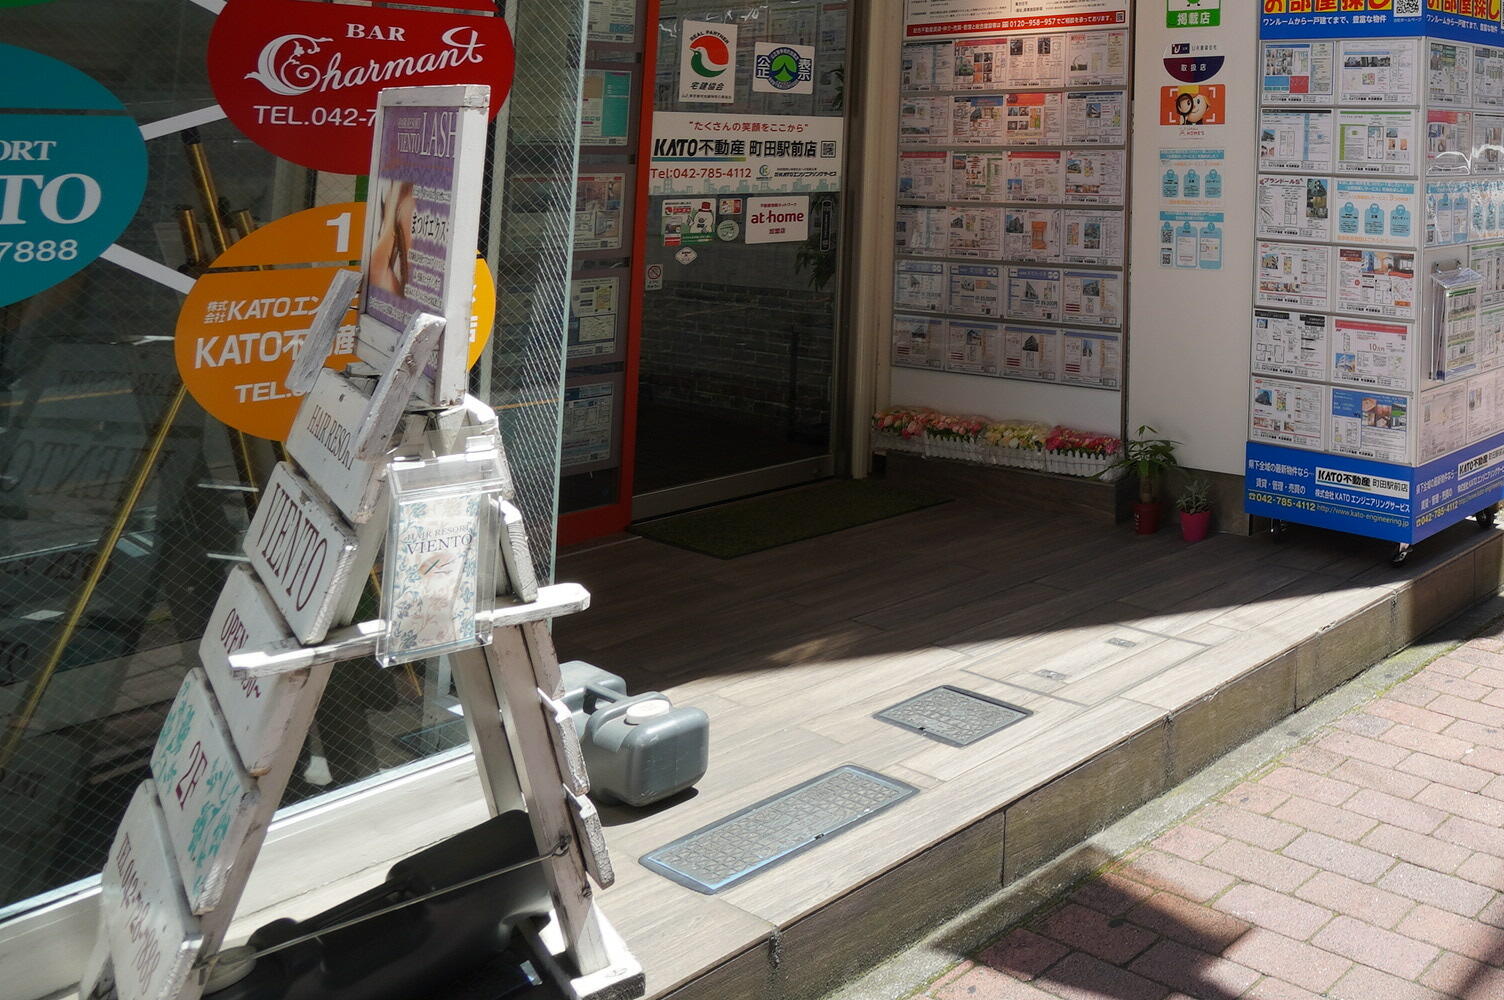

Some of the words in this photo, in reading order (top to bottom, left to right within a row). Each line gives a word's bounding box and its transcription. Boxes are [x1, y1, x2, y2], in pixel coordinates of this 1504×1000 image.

[1177, 12, 1211, 25] 掲載店
[345, 23, 406, 43] BAR
[244, 27, 486, 97] Charmant
[757, 56, 770, 78] 公正
[690, 81, 725, 91] 宅建協会
[653, 139, 746, 157] KATO不動産
[750, 140, 818, 158] 町田駅前店
[650, 168, 752, 179] Tel:042-785-4112
[751, 213, 764, 224] at
[767, 210, 804, 224] home
[1318, 469, 1371, 487] KATO不動産
[1372, 478, 1409, 493] 町田駅前店
[1256, 494, 1317, 512] 042-785-4112
[256, 482, 328, 613] VIENTO
[407, 534, 472, 555] VIENTO
